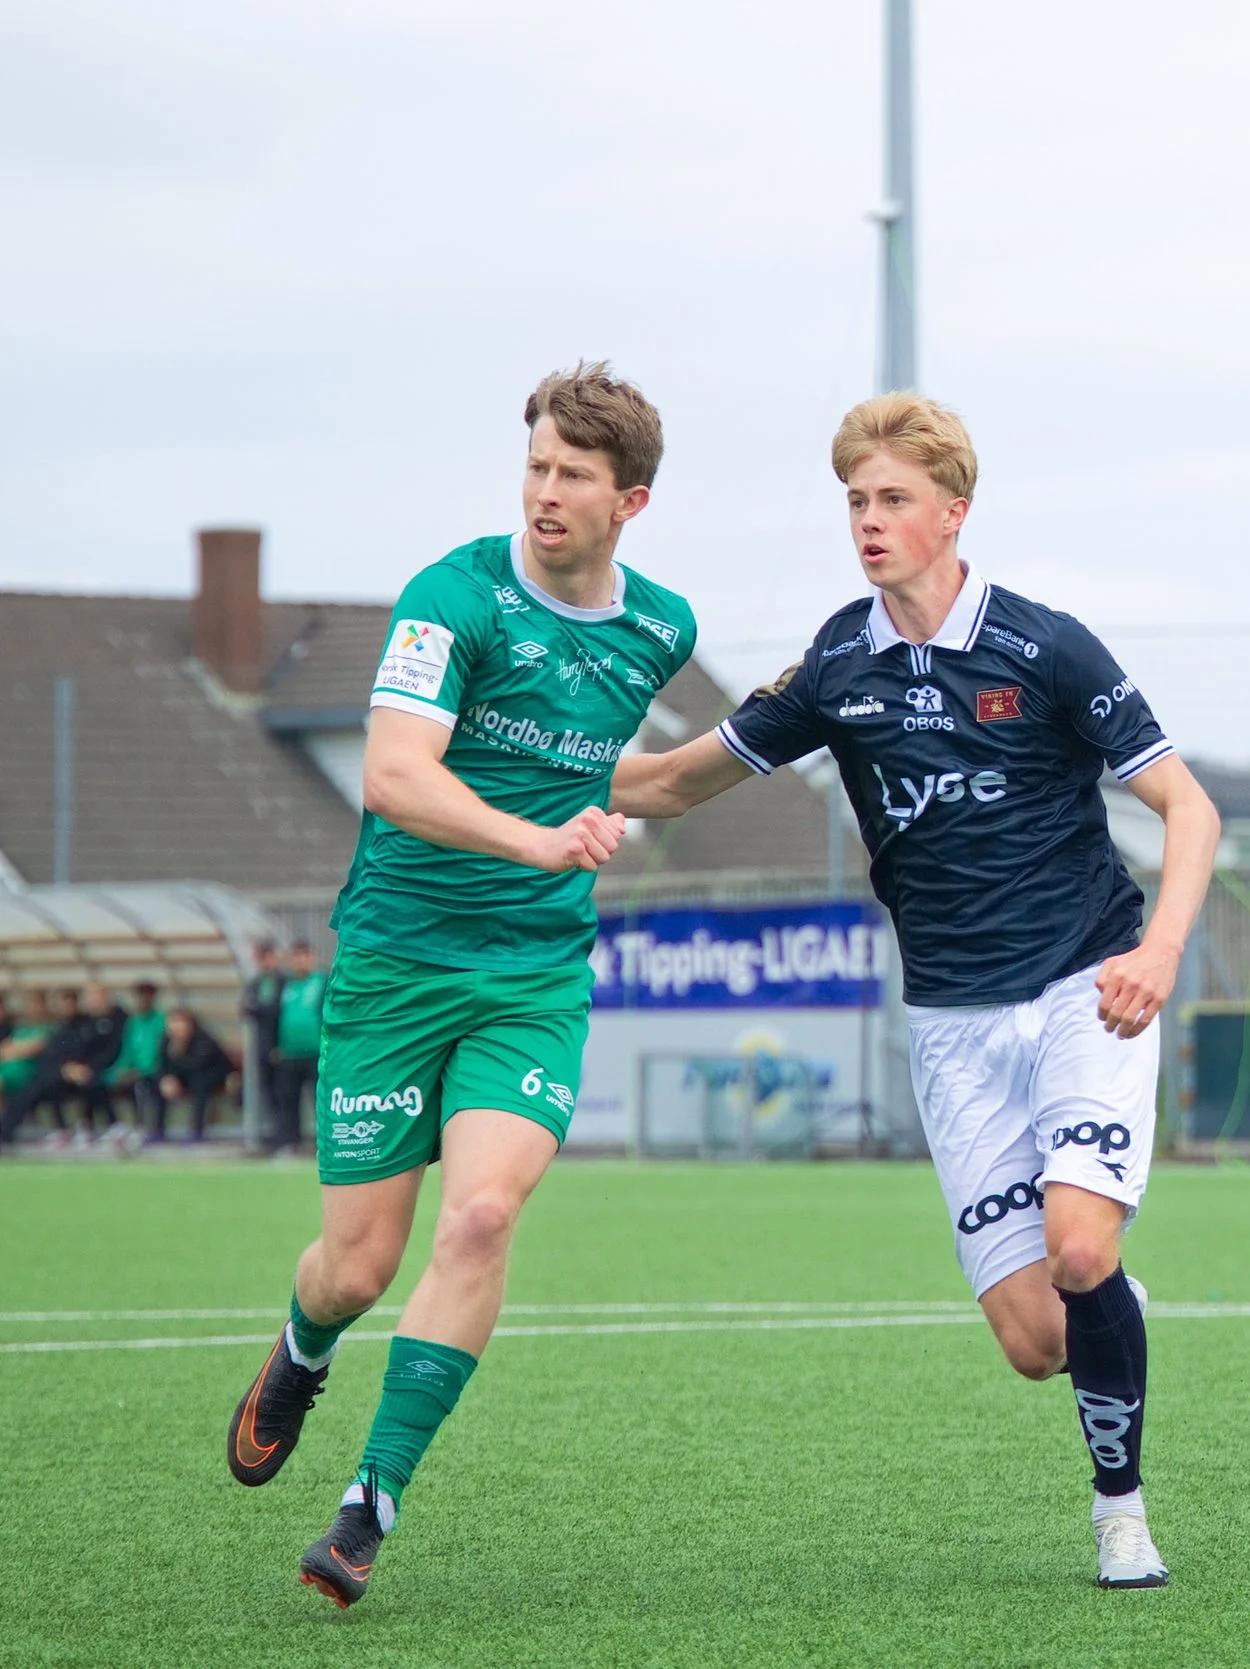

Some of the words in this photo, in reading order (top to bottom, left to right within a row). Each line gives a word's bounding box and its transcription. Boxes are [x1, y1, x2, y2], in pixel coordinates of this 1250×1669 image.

[467, 702, 557, 750] Nordbø
[903, 716, 955, 732] OBOS
[871, 763, 1008, 832] Lyse
[521, 1067, 545, 1096] 6
[1051, 1121, 1131, 1155] oop
